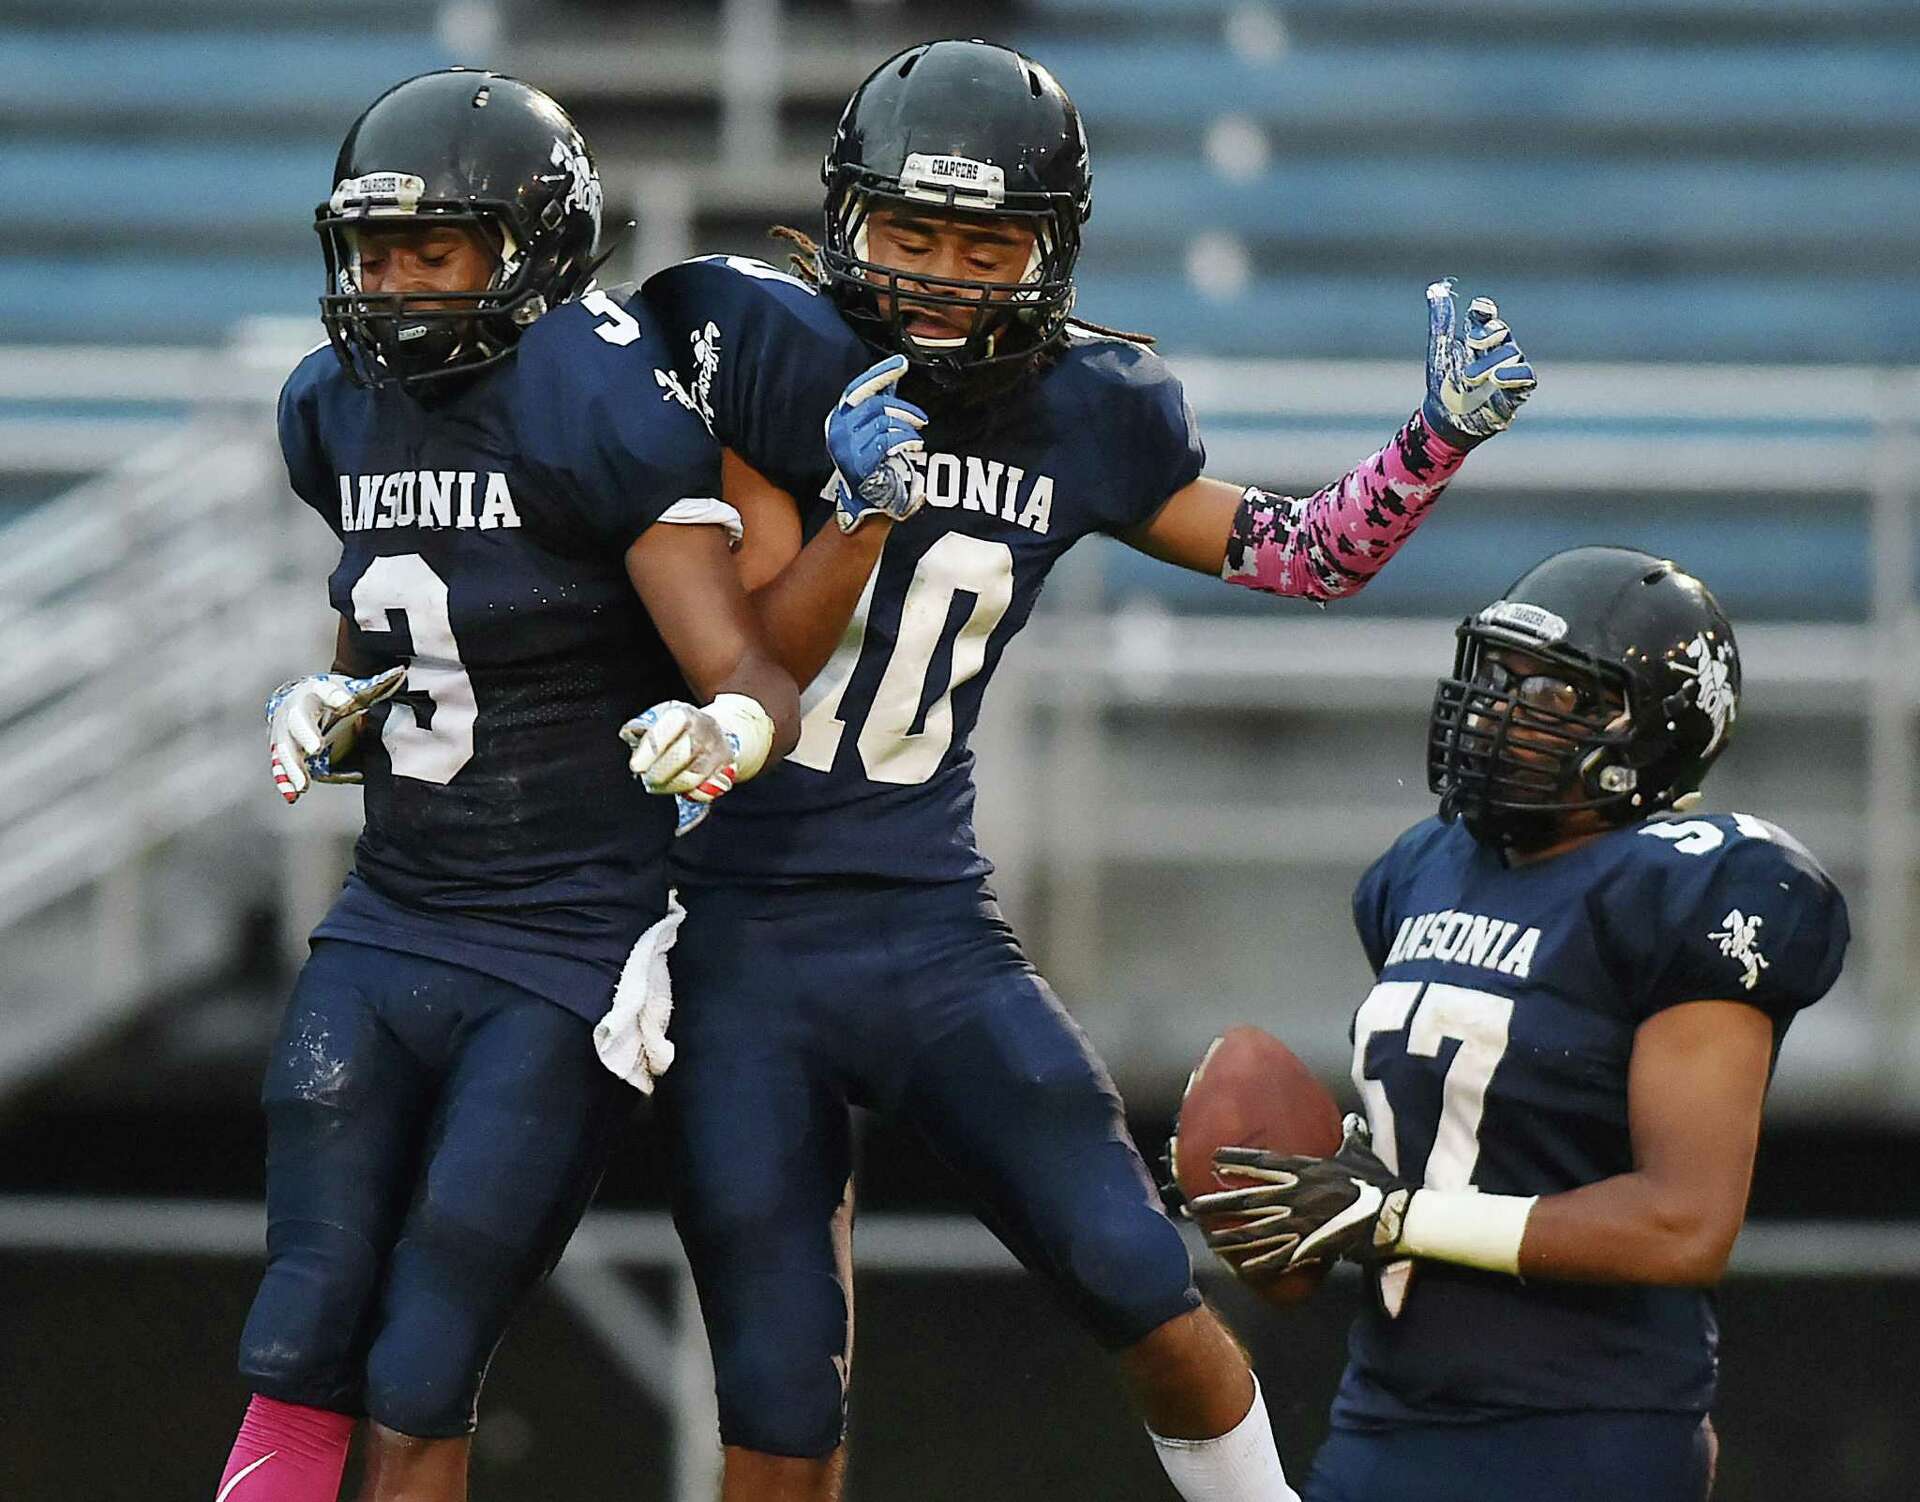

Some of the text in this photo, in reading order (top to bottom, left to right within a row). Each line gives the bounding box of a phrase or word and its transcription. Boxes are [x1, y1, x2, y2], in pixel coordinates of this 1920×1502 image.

[931, 159, 979, 180] CHARGERS
[339, 470, 523, 532] ANSONIA
[351, 553, 479, 785] 3
[1384, 909, 1542, 979] ANSONIA
[1350, 980, 1516, 1318] 57
